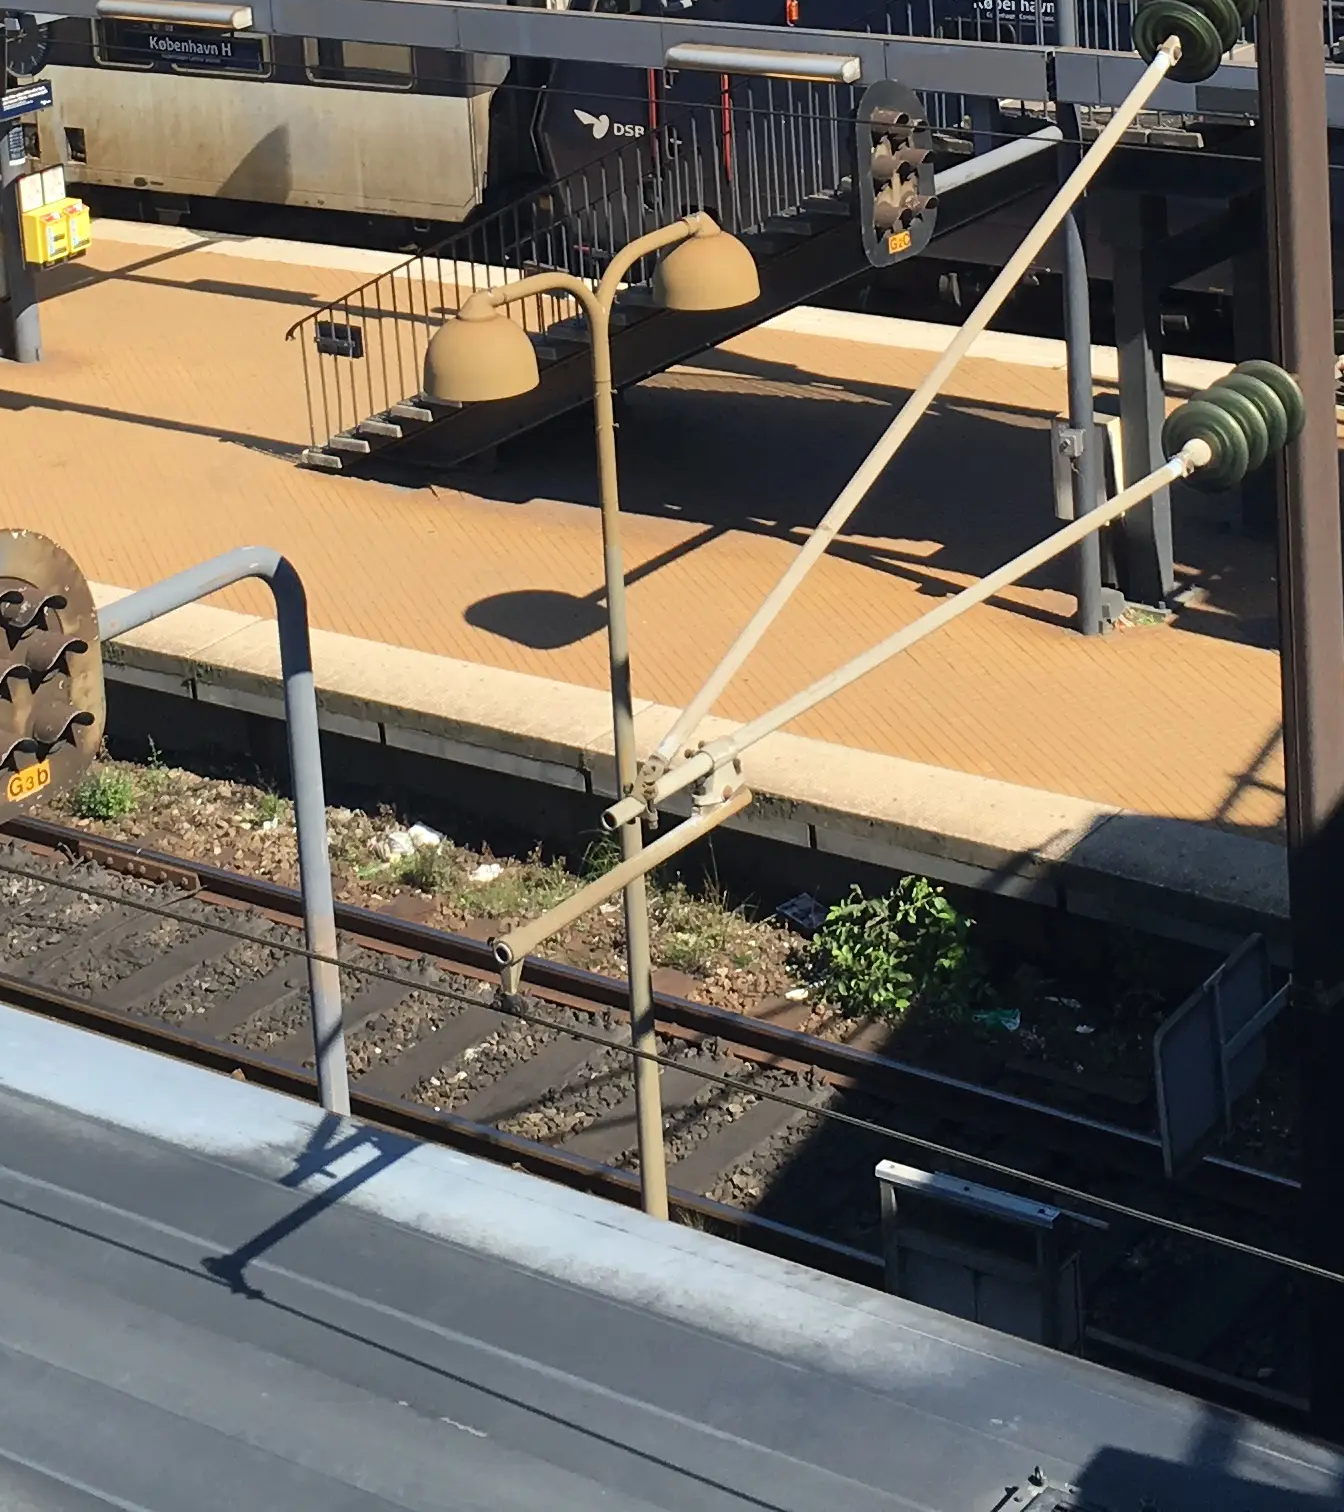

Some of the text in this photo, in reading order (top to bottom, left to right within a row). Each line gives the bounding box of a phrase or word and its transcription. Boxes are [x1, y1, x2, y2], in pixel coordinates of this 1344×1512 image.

[149, 36, 232, 56] København H
[9, 768, 49, 797] G3b
